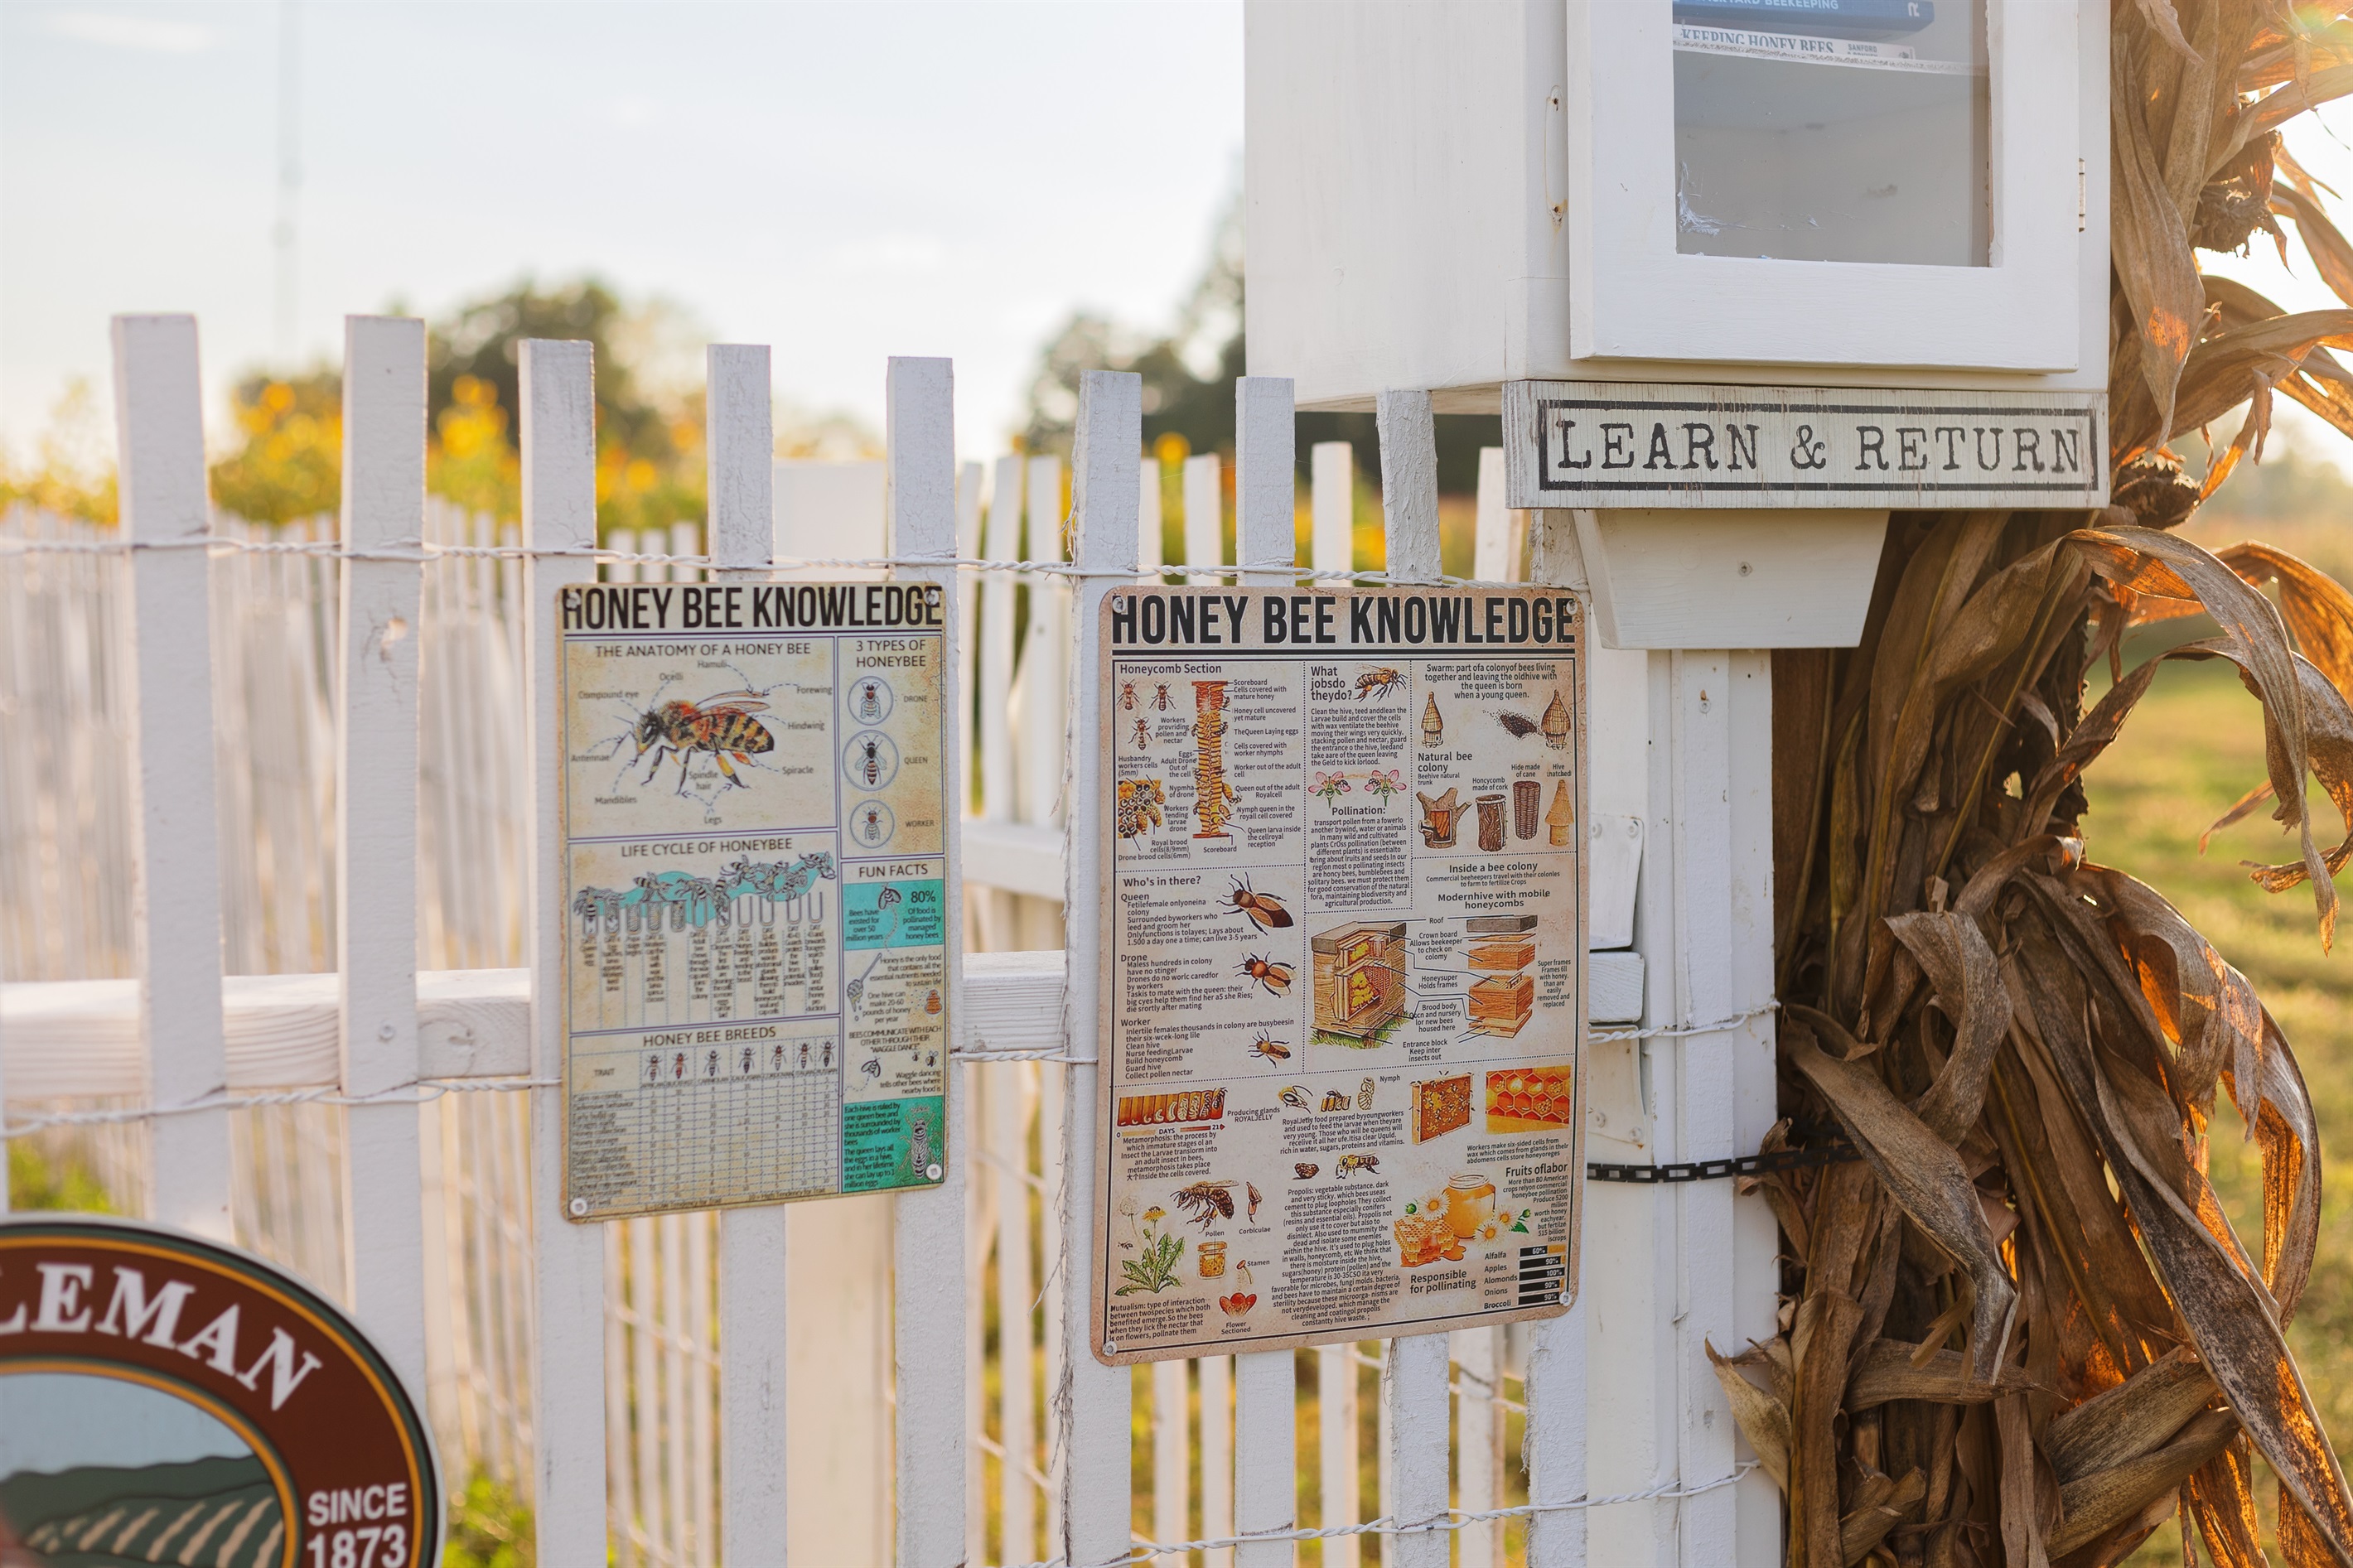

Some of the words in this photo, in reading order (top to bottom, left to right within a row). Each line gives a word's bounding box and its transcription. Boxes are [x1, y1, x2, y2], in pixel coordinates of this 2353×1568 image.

[1766, 0, 1838, 10] BEEKEEPING
[1848, 43, 1877, 53] SANFORD
[1556, 419, 1759, 473] LEARN
[1790, 424, 1826, 471] &
[1856, 424, 2080, 474] RETURN
[563, 587, 673, 630] HONEY
[684, 586, 742, 628] BEE
[753, 586, 943, 628] KNOWLEDGE
[1112, 595, 1249, 645] HONEY
[1263, 596, 1336, 644] BEE
[1350, 596, 1576, 644] KNOWLEDGE
[596, 644, 624, 658] THE
[627, 644, 696, 657] ANATOMY
[701, 644, 720, 656] OF
[722, 644, 733, 655] A
[735, 643, 784, 655] HONEY
[787, 643, 810, 654] BEE
[857, 640, 862, 652] 3
[867, 639, 905, 652] TYPES
[909, 639, 925, 651] OF
[857, 656, 926, 668] HONEYBEE
[1120, 664, 1181, 676] Honeycomb
[1184, 664, 1222, 673] Section
[1311, 666, 1337, 676] What
[1457, 664, 1471, 673] part
[1425, 673, 1457, 683] together
[1473, 673, 1499, 682] leaving
[797, 687, 833, 695] Forewing
[1311, 690, 1352, 702] theydo?
[788, 722, 824, 731] Hindwing
[1418, 752, 1452, 761] Natural
[1457, 752, 1472, 760] bee
[783, 767, 814, 775] Spiracle
[1418, 764, 1448, 774] colony
[1332, 806, 1386, 816] Pollination:
[621, 845, 651, 858] LIFE
[654, 843, 696, 856] CYCLE
[699, 842, 717, 853] OF
[720, 837, 793, 852] HONEYBEE
[859, 866, 886, 878] FUN
[890, 864, 928, 876] FACTS
[1450, 865, 1478, 873] Inside
[1507, 862, 1538, 872] colony
[1123, 878, 1155, 887] Who's
[1157, 877, 1166, 885] in
[1169, 876, 1201, 885] there?
[911, 890, 935, 903] 80%
[1121, 893, 1149, 902] Queen
[1438, 892, 1494, 902] Modernhive
[1496, 890, 1516, 899] with
[1520, 890, 1550, 898] mobile
[1466, 900, 1524, 909] honeycombs
[1121, 954, 1148, 963] Drone
[1121, 1019, 1151, 1027] Worker
[643, 1033, 693, 1047] HONEY
[697, 1030, 722, 1044] BEE
[726, 1026, 775, 1041] BREEDS
[1380, 1075, 1400, 1083] Nymph
[1505, 1165, 1532, 1178] Fruits
[1485, 1252, 1506, 1260] Alfalfa
[1485, 1264, 1507, 1273] Apples
[1411, 1270, 1466, 1284] Responsible
[1484, 1274, 1518, 1284] Alomonds
[1410, 1284, 1424, 1294] for
[1427, 1280, 1476, 1294] pollinating
[1484, 1300, 1511, 1310] Broccoli
[307, 1482, 407, 1527] SINCE
[307, 1523, 407, 1568] 1873
